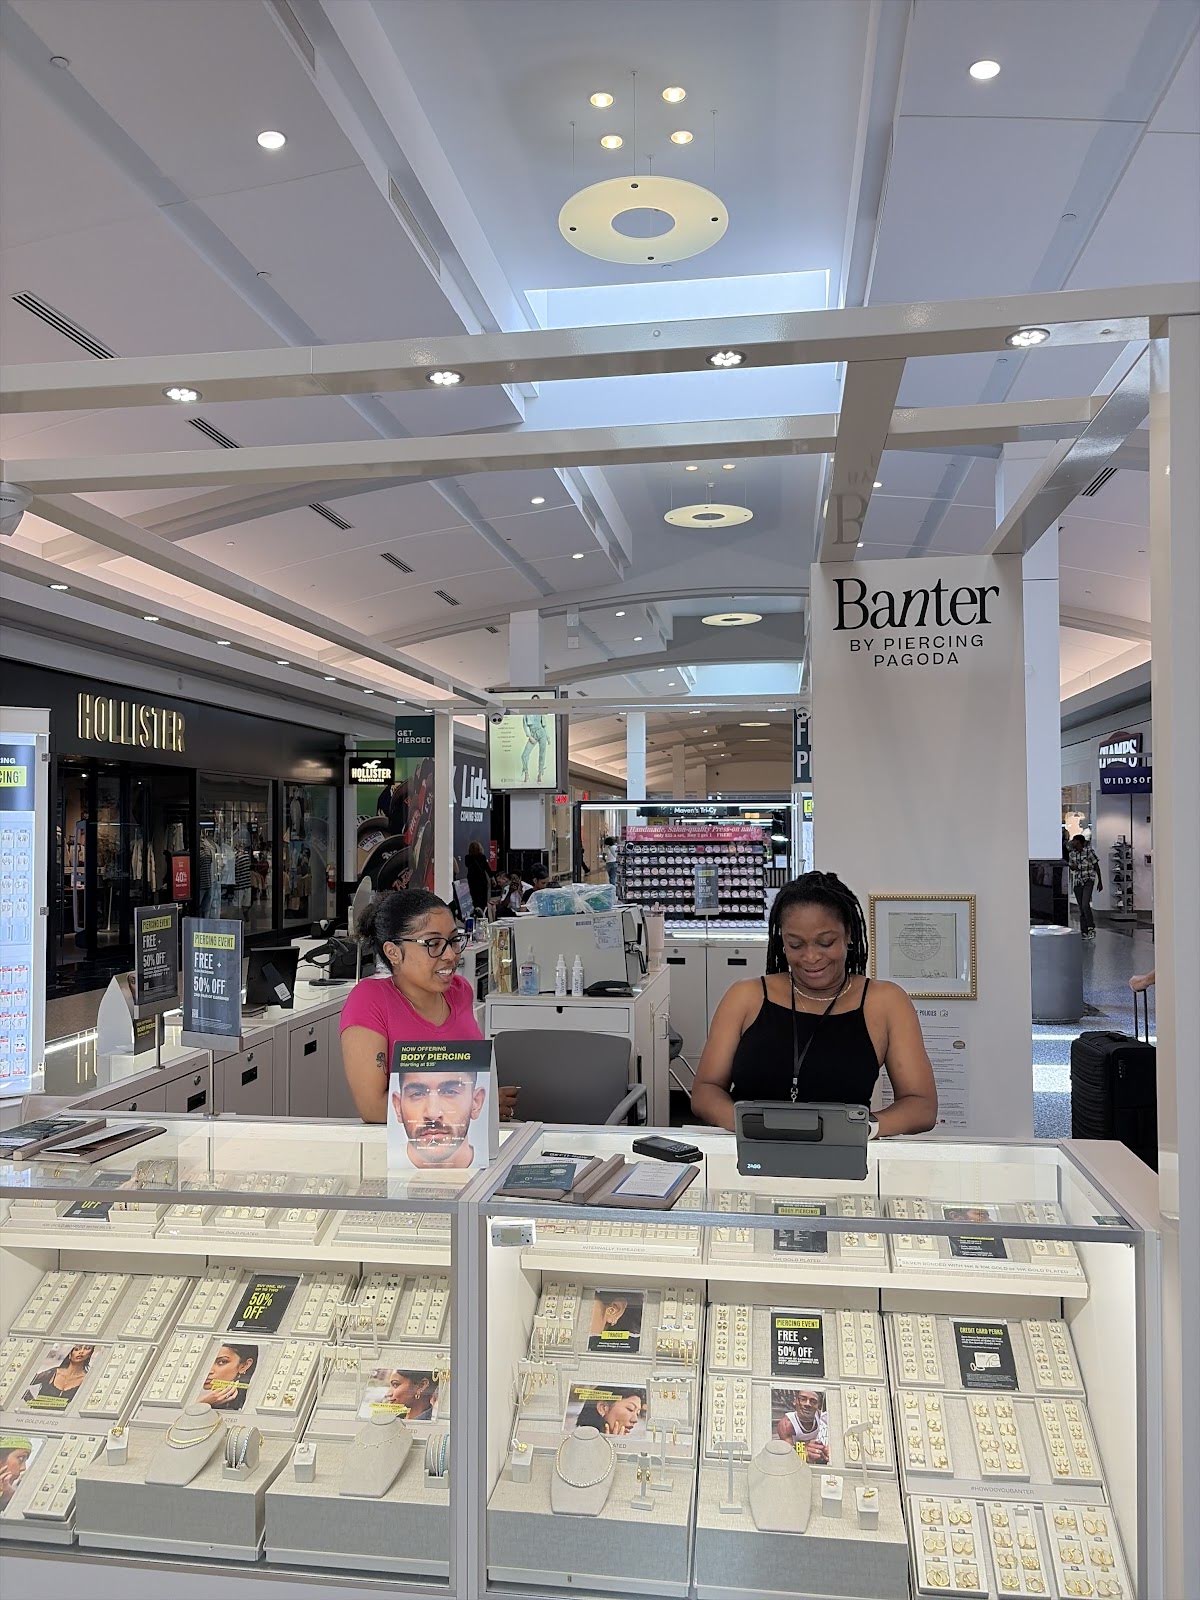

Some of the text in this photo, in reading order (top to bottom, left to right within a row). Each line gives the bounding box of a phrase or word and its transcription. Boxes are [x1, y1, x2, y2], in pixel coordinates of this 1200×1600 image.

[832, 577, 1000, 631] Banter
[850, 634, 984, 652] BY PIERCING
[874, 651, 959, 667] PAGODA
[77, 692, 186, 753] HOLLISTER
[351, 768, 392, 779] HOLLISTER
[461, 764, 489, 809] Lids
[143, 934, 156, 948] FREE
[195, 934, 234, 947] PIERCING EVENT
[143, 952, 166, 967] 50% OFF
[194, 952, 213, 969] FREE
[193, 976, 226, 994] 50% OFF
[401, 1053, 426, 1061] BODY
[249, 1292, 273, 1306] 50%
[243, 1305, 266, 1319] OFF
[777, 1319, 818, 1328] PIERCING EVENT
[778, 1330, 799, 1341] FREE
[778, 1345, 814, 1357] 50% OFF
